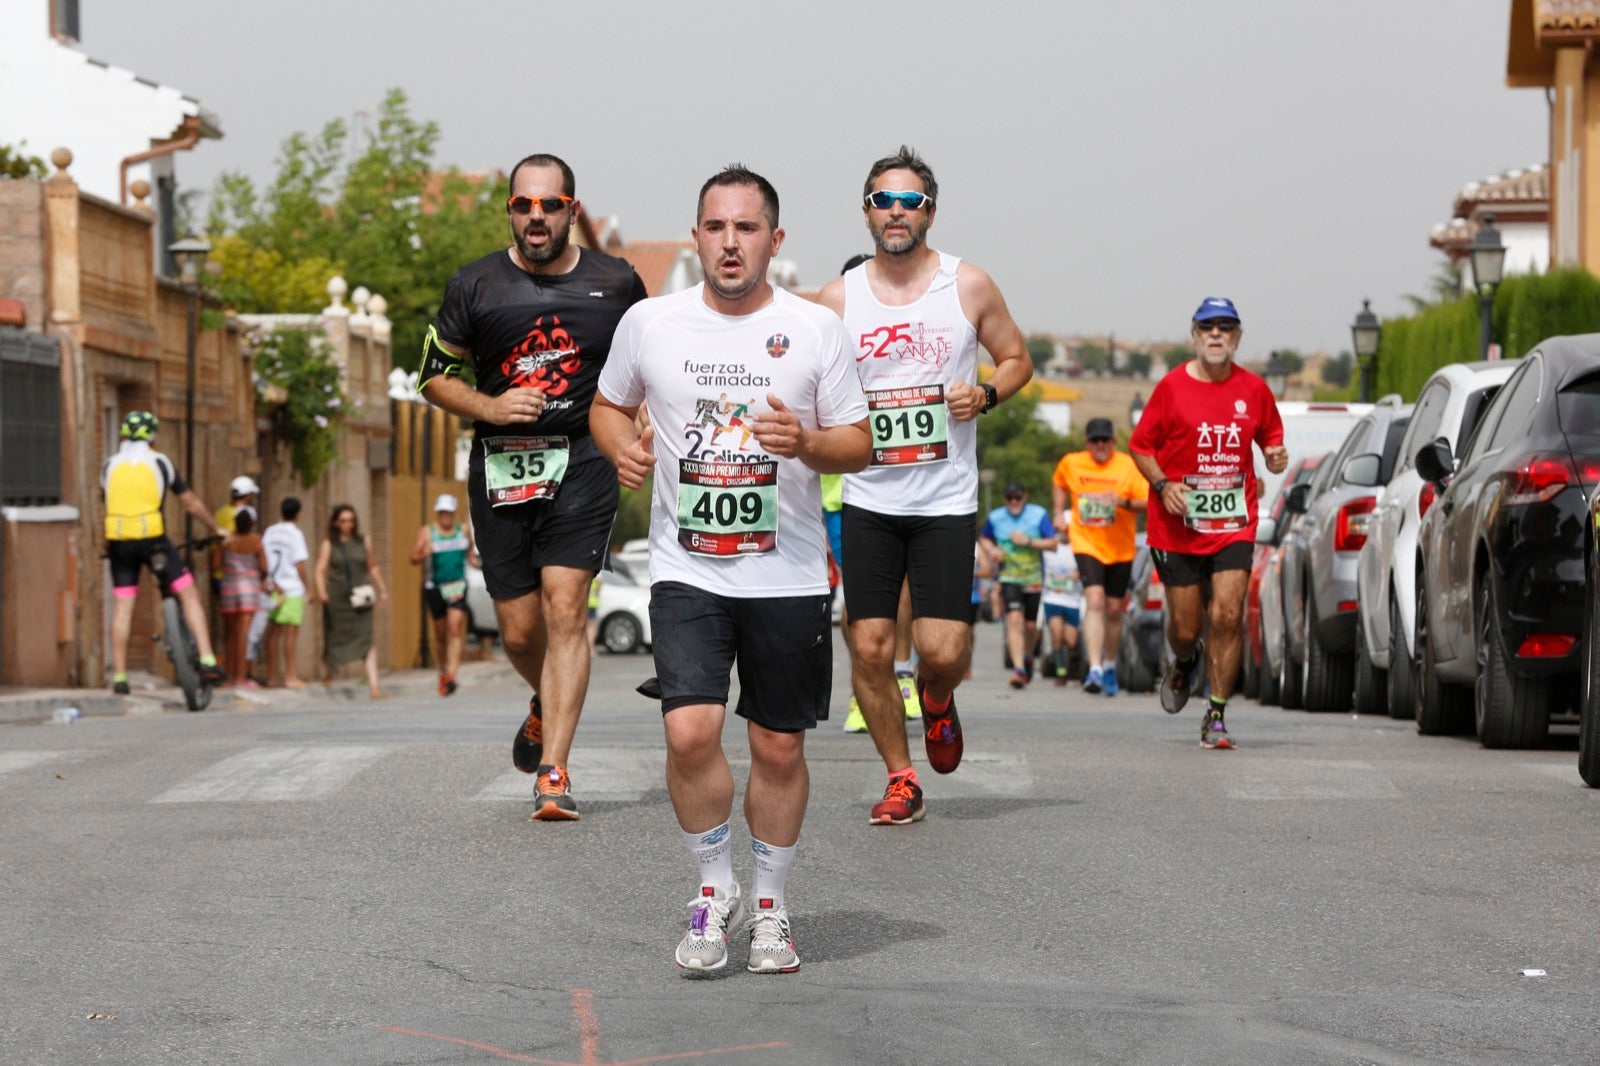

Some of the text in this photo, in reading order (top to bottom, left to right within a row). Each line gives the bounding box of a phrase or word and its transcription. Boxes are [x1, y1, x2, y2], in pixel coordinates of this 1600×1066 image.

[856, 322, 912, 362] 525
[684, 360, 746, 374] fuerzas
[696, 373, 771, 386] armadas
[875, 410, 934, 442] 919
[510, 452, 545, 480] 35
[1197, 452, 1240, 463] De Oficio
[698, 464, 714, 476] GRAN
[716, 465, 741, 476] PREMIO
[742, 466, 750, 476] DE
[751, 464, 772, 475] FONDO
[692, 491, 763, 526] 409
[1195, 493, 1236, 514] 280
